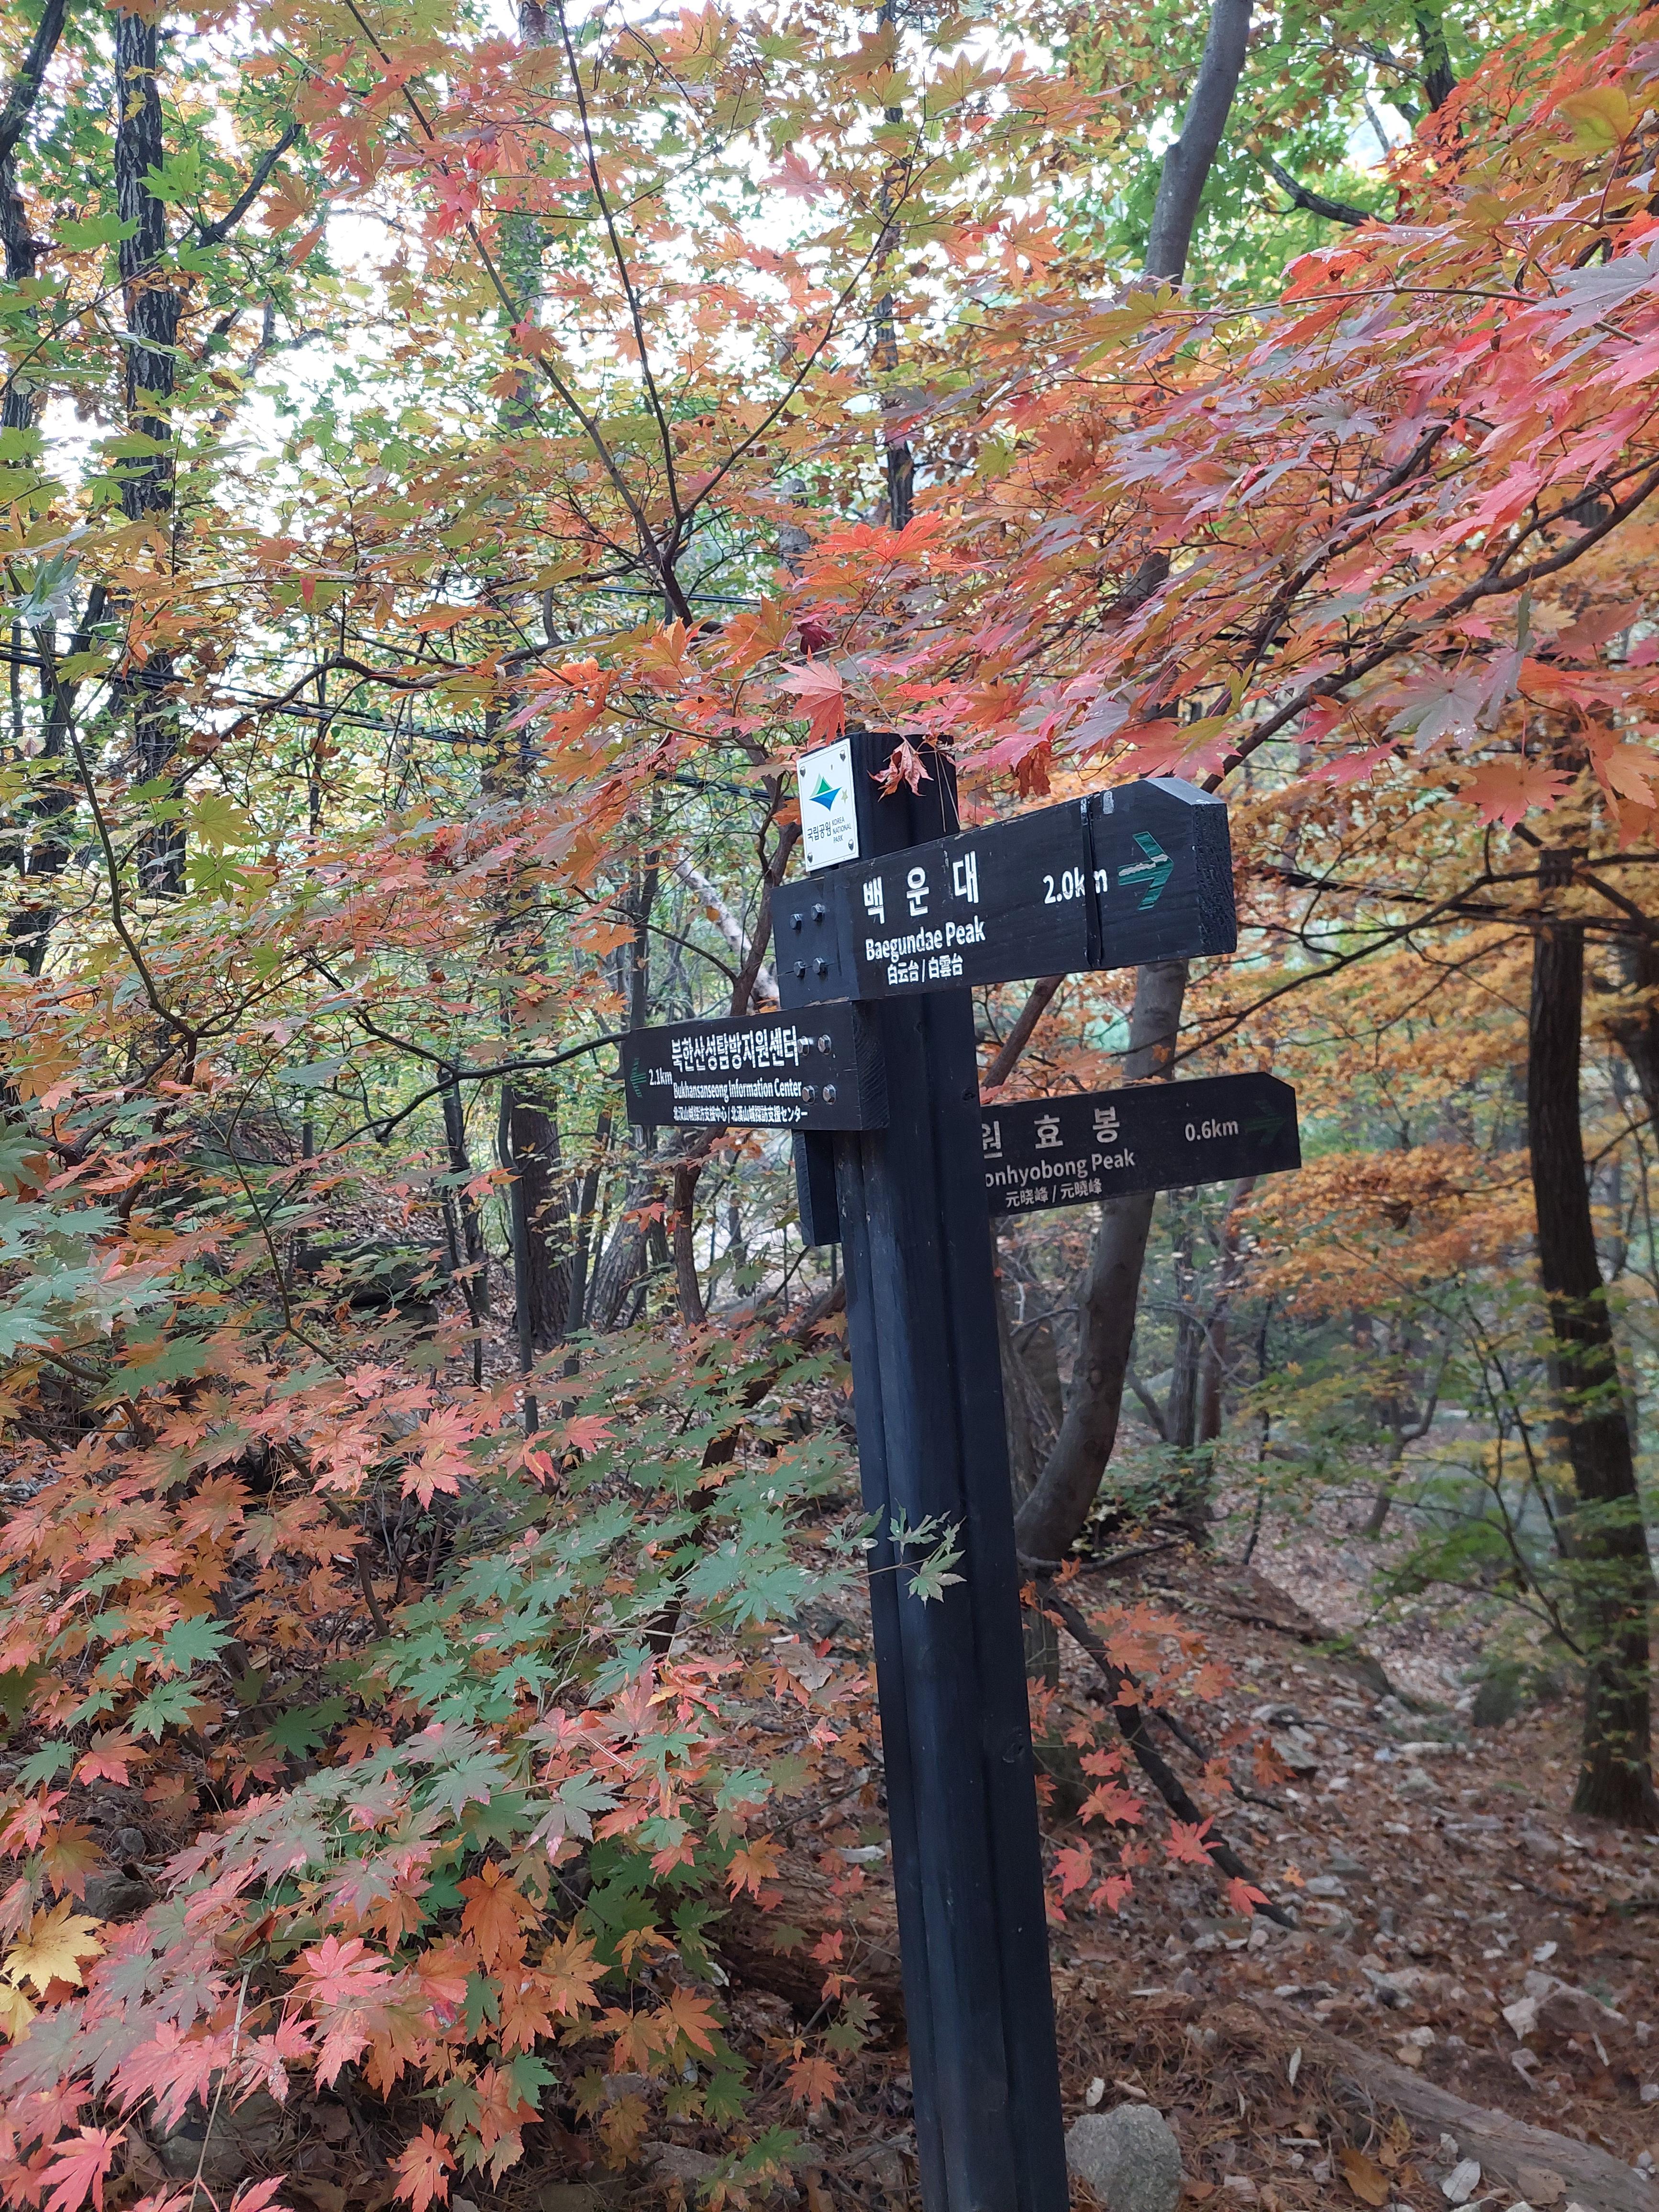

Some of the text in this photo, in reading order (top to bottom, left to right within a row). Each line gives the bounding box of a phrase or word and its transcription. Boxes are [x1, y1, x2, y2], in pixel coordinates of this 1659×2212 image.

[807, 821, 831, 842] 국립공원
[832, 816, 845, 826] KOREA
[832, 823, 852, 835] NATIONAL
[833, 835, 843, 843] PARK
[865, 915, 986, 963] Baegundae Peak
[671, 1025, 799, 1073] 북한산성탐방지원센터
[649, 1067, 672, 1086] 2.1km
[673, 1077, 802, 1103] Bukhansanseong Information Center
[1185, 1118, 1239, 1141] 0.6km
[985, 1148, 1136, 1187] onhyobong Peak
